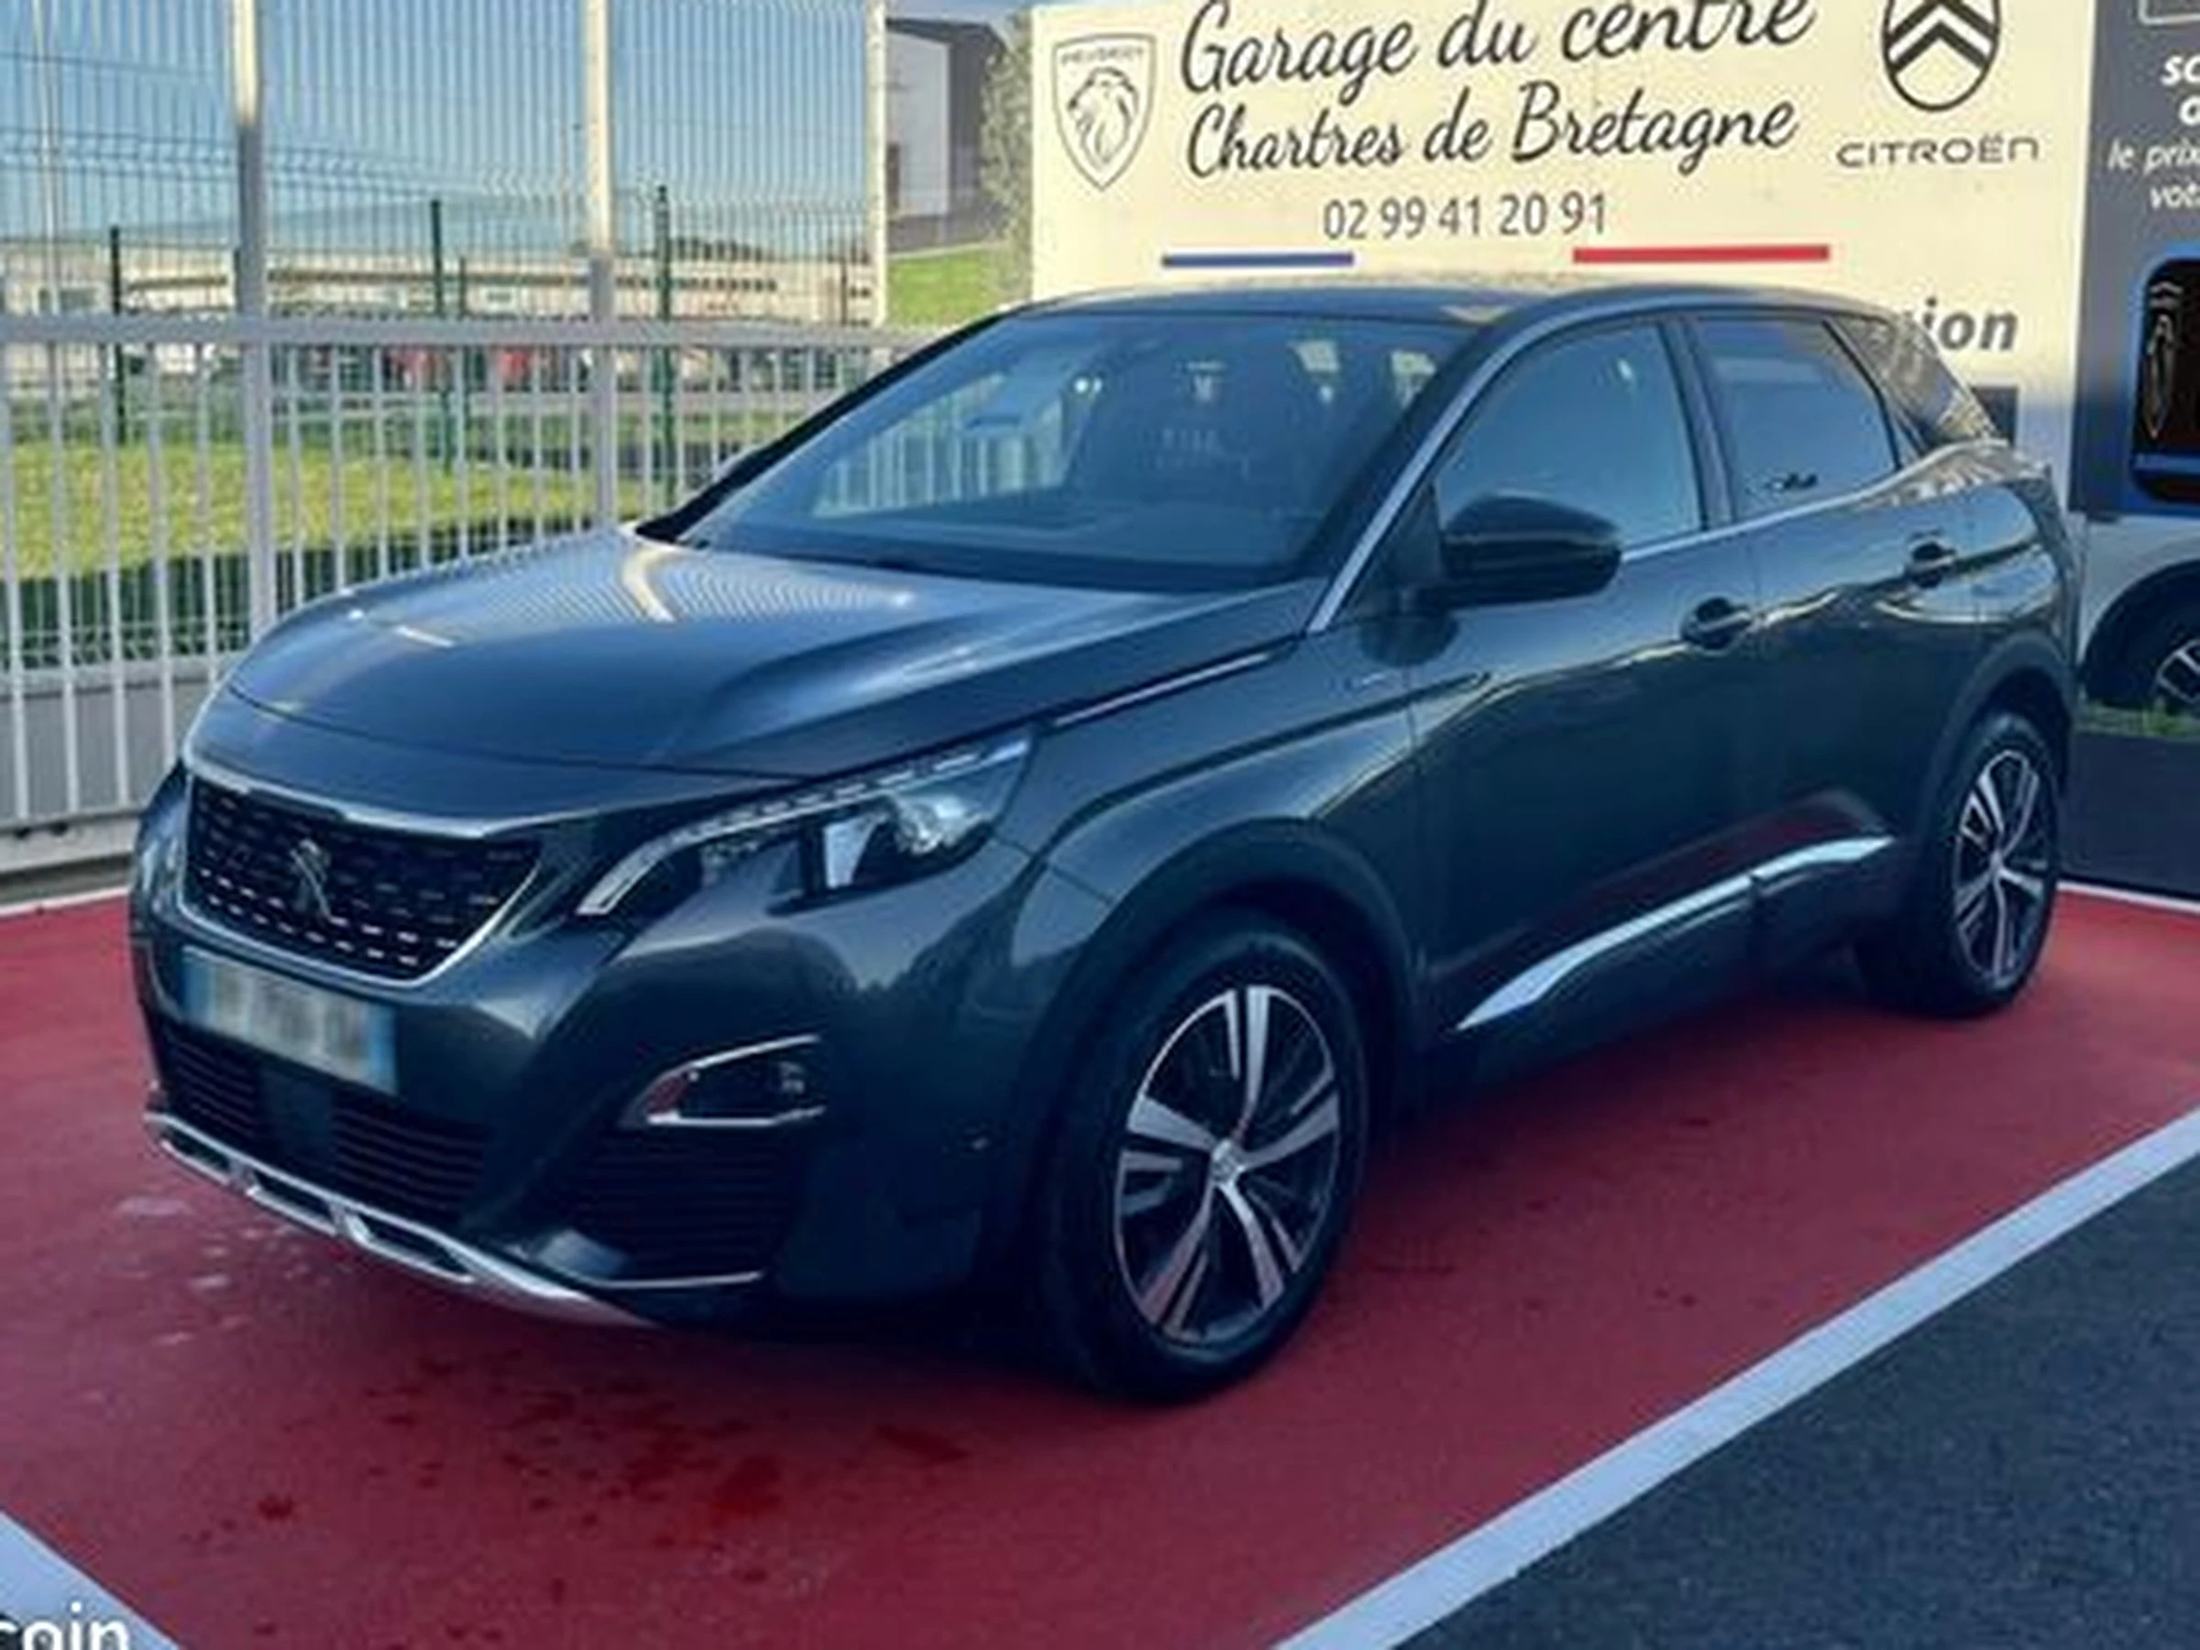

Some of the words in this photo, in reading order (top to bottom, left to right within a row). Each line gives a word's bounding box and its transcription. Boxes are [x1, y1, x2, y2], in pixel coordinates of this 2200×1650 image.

[1181, 0, 1419, 106] Garage
[1437, 0, 1540, 68] du
[1561, 0, 1818, 62] centre
[1187, 102, 1406, 178] Chartres
[1423, 85, 1494, 162] de
[1511, 79, 1800, 176] Bretagne
[2107, 137, 2136, 171] le
[1322, 198, 1369, 240] 02
[1378, 195, 1427, 240] 99
[1437, 195, 1481, 236] 41
[1499, 192, 1548, 236] 20
[1559, 190, 1605, 235] 91
[1921, 296, 2018, 350] ion
